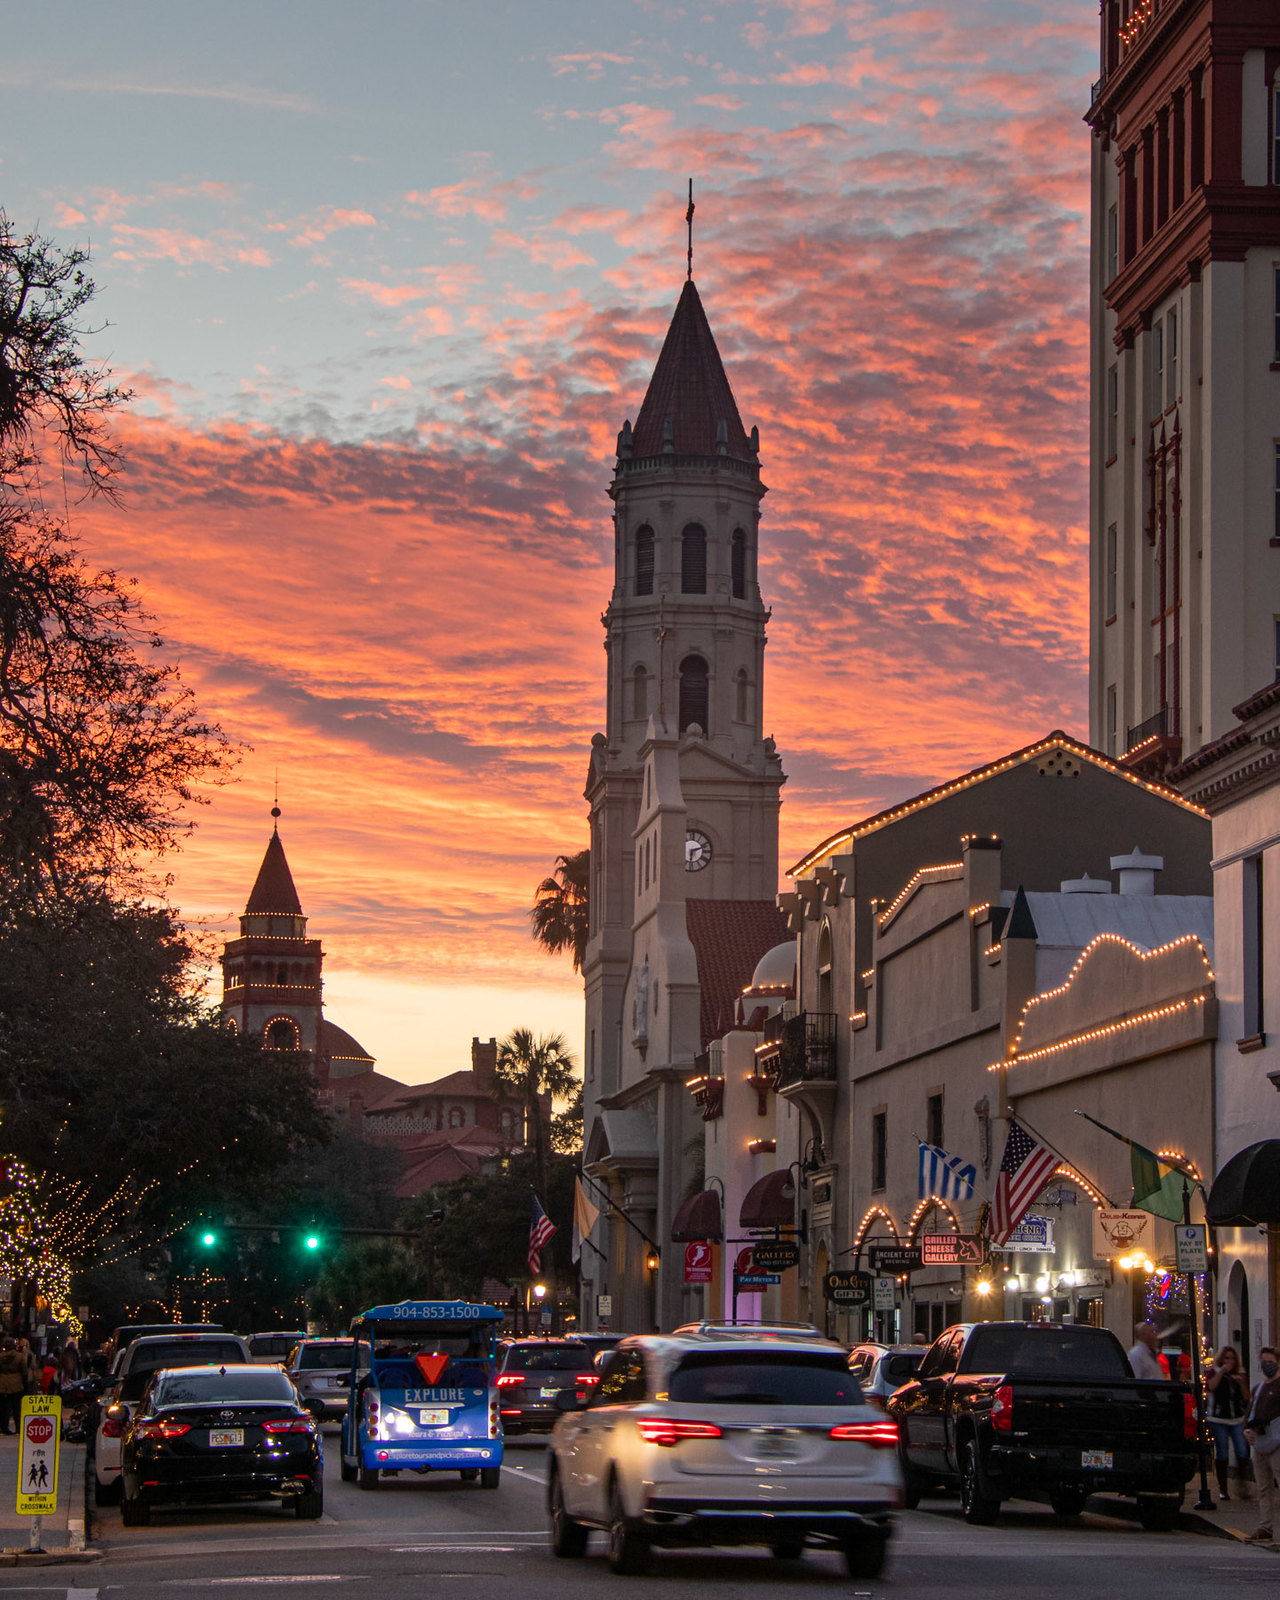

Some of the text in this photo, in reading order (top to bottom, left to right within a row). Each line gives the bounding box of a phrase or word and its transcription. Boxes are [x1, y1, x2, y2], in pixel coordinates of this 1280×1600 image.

[925, 1236, 957, 1244] GRILLED
[925, 1245, 955, 1253] CHEESE
[876, 1251, 902, 1259] ANCIENT
[925, 1253, 959, 1262] GALLERY
[829, 1275, 869, 1288] OLD CITY
[836, 1290, 864, 1298] GIFTS
[393, 1306, 480, 1319] 904-853-1500
[404, 1388, 466, 1402] EXPLORE
[28, 1396, 55, 1404] STATE
[31, 1405, 50, 1413] LAW
[27, 1425, 52, 1436] STOP
